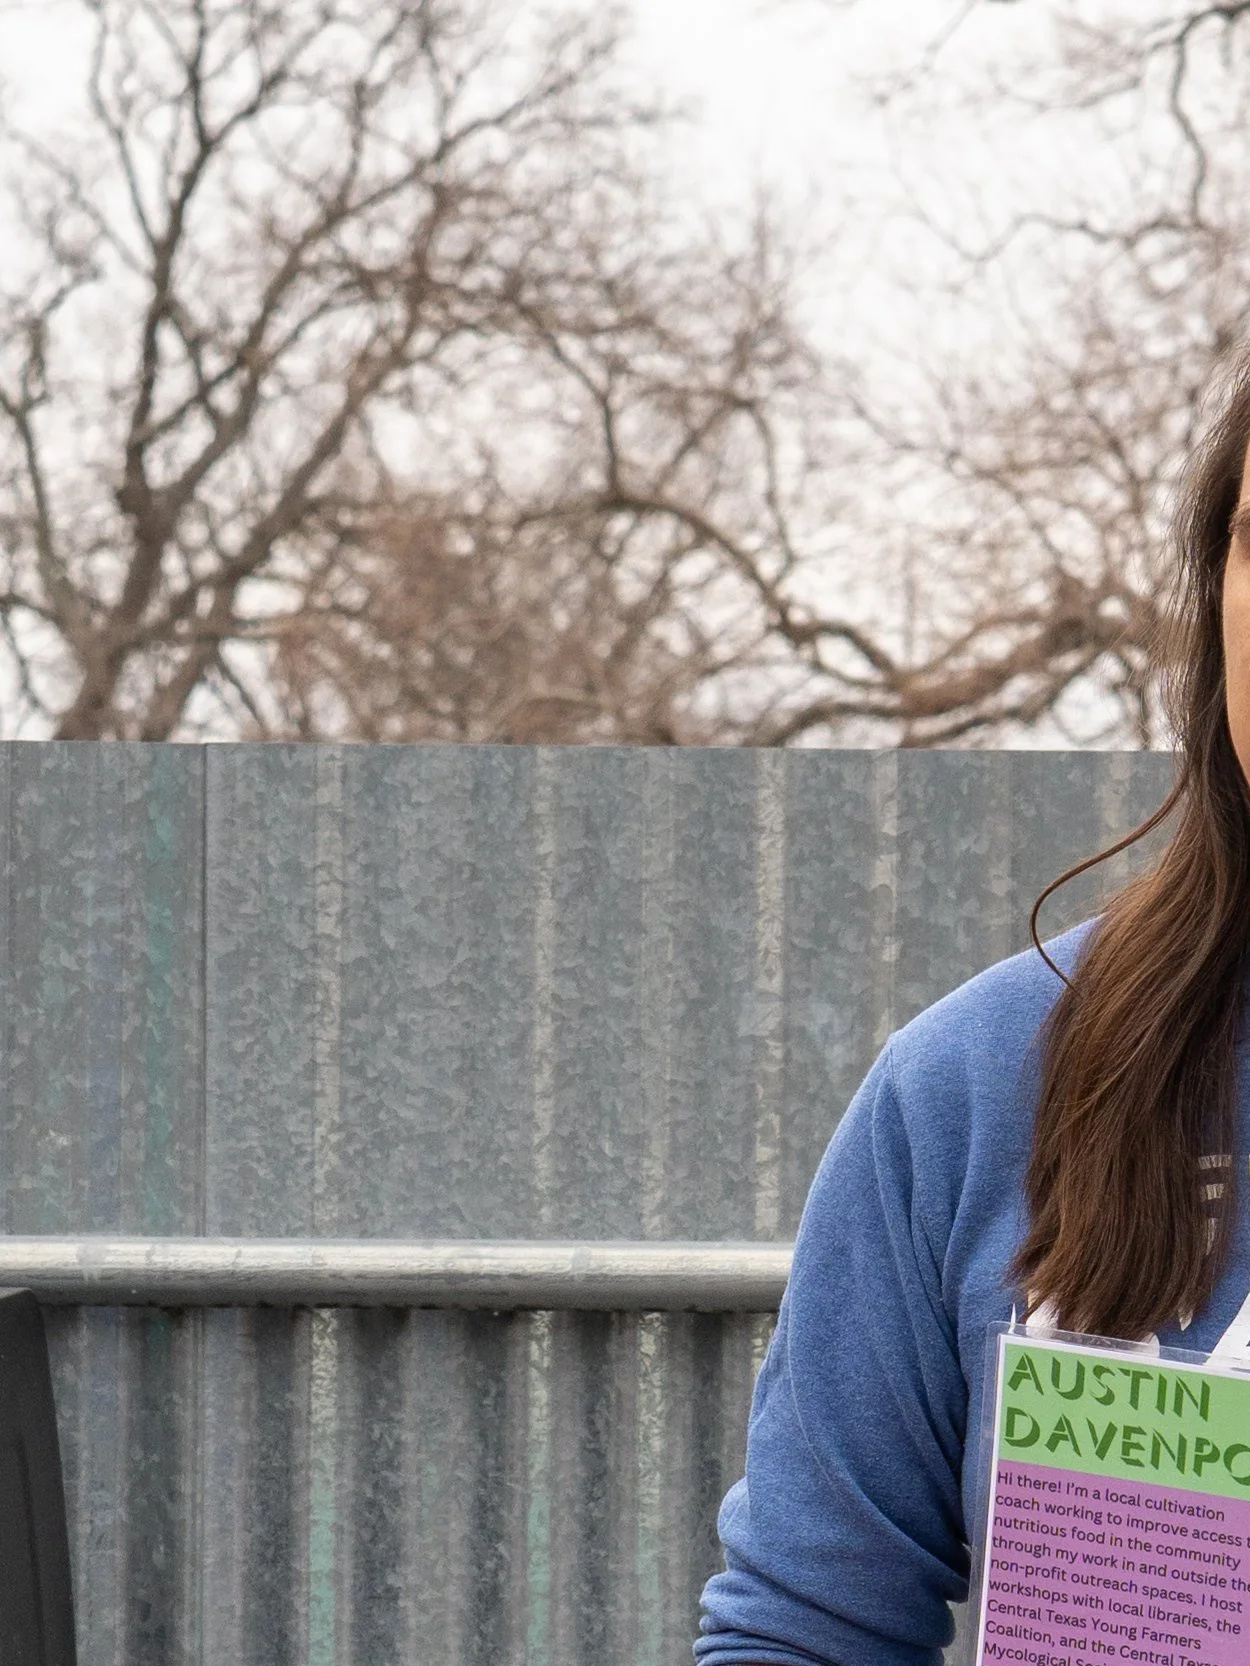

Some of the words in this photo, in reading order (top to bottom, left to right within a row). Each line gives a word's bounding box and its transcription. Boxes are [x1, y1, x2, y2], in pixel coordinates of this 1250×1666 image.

[1007, 1352, 1211, 1423] AUSTIN
[995, 1495, 1040, 1511] coach
[1044, 1503, 1103, 1525] working
[1107, 1512, 1122, 1525] to
[1127, 1514, 1188, 1537] improve
[1192, 1529, 1242, 1547] access
[997, 1471, 1013, 1485] Hi
[1017, 1474, 1061, 1493] there!
[1092, 1489, 1101, 1500] a
[1105, 1488, 1141, 1507] local
[1145, 1498, 1225, 1522] cultivation
[992, 1535, 1051, 1558] through
[1056, 1549, 1078, 1564] my
[1082, 1553, 1118, 1569] work
[1122, 1557, 1135, 1571] in
[1139, 1563, 1167, 1577] and
[1171, 1569, 1227, 1588] outside
[994, 1516, 1067, 1538] nutritious
[1071, 1526, 1105, 1544] food
[1110, 1533, 1123, 1547] in
[1128, 1537, 1152, 1552] the
[1156, 1544, 1241, 1571] community
[989, 1580, 1068, 1604] workshops
[1073, 1594, 1104, 1610] with
[1108, 1598, 1144, 1617] local
[1148, 1605, 1211, 1632] libraries,
[1216, 1619, 1241, 1635] the
[991, 1559, 1067, 1582] non-profit
[1071, 1573, 1138, 1593] outreach
[1142, 1586, 1197, 1605] spaces.
[1202, 1594, 1205, 1606] I
[1210, 1595, 1243, 1614] host
[986, 1620, 1055, 1647] Coalition,
[1059, 1636, 1087, 1650] and
[1091, 1640, 1115, 1656] the
[1120, 1645, 1174, 1666] Central
[987, 1599, 1041, 1621] Central
[1046, 1609, 1087, 1628] Texas
[1091, 1617, 1137, 1641] Young
[1142, 1627, 1201, 1650] Farmers
